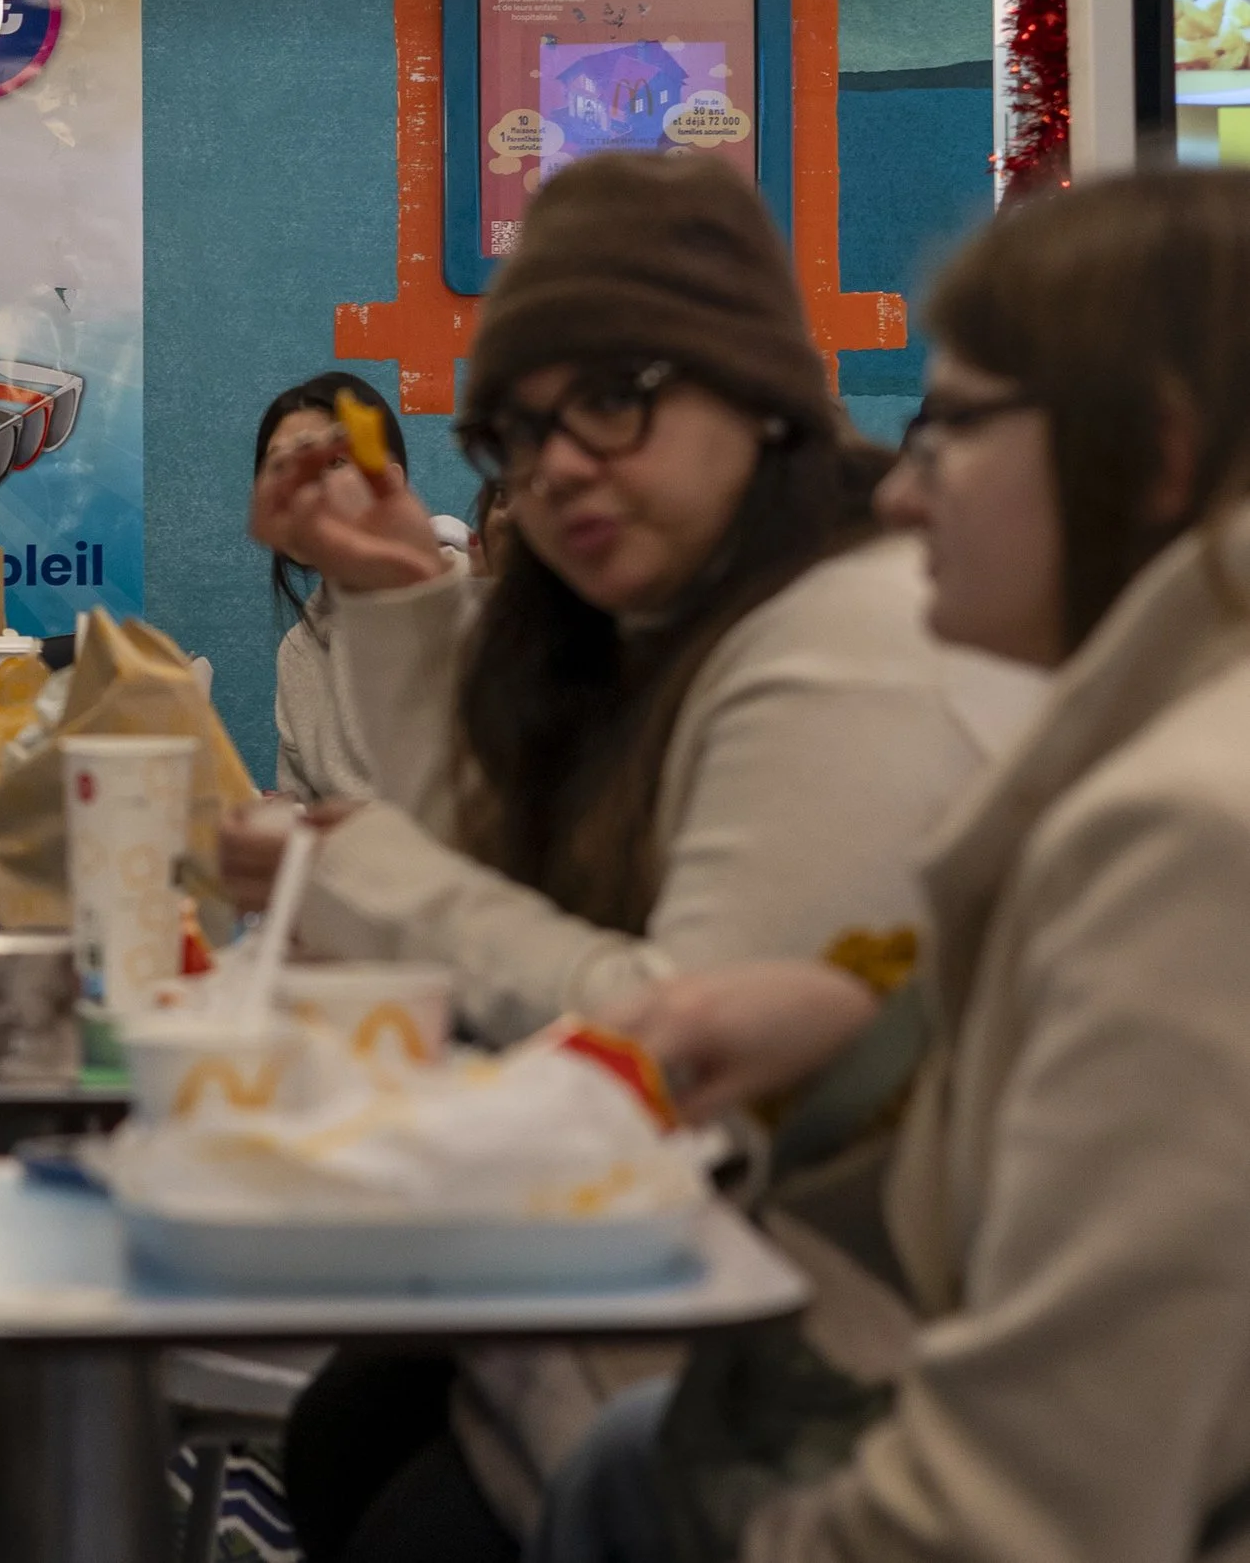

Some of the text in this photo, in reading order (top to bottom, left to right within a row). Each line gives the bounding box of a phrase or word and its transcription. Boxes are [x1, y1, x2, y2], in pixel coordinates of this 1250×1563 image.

[693, 106, 706, 115] 30
[518, 115, 529, 126] 10
[672, 116, 741, 128] et déjà 72 000
[499, 131, 506, 143] 1
[3, 540, 104, 587] oleil
